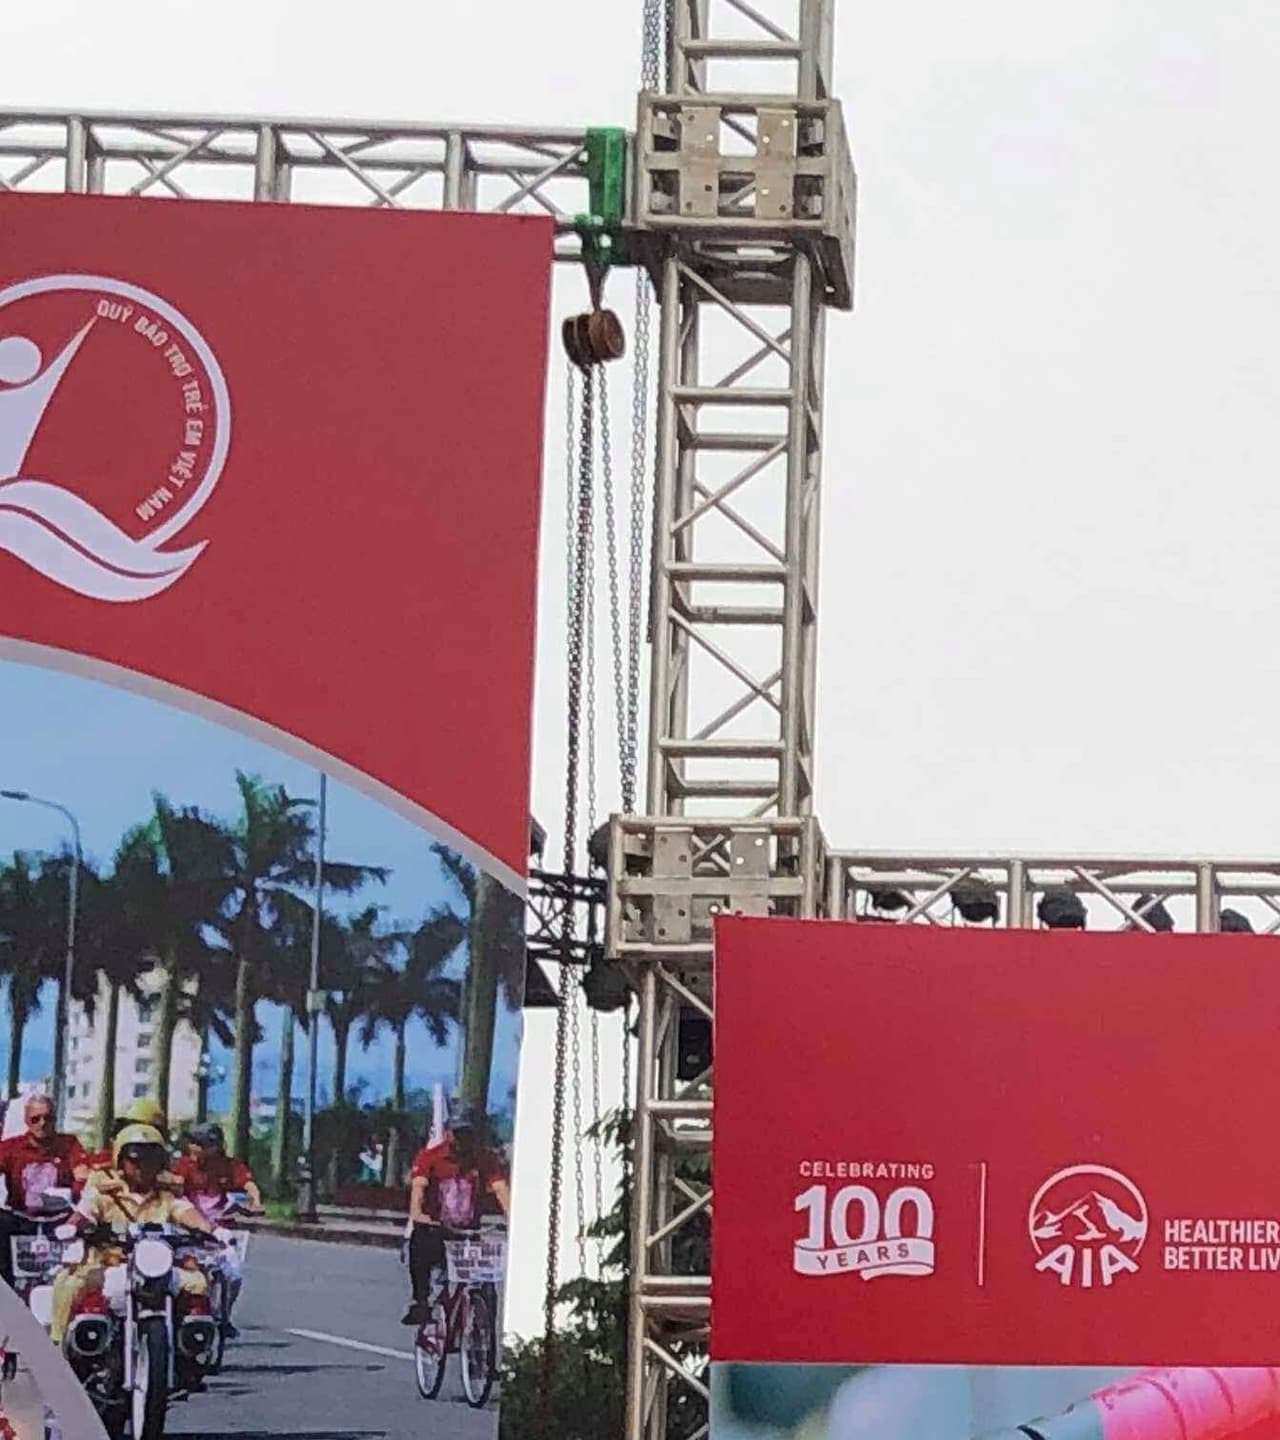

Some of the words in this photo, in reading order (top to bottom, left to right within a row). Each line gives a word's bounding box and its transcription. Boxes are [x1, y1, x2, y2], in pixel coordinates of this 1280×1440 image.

[184, 420, 203, 446] EM
[135, 487, 174, 522] NAM
[800, 1160, 935, 1180] CELEBRATING
[794, 1184, 934, 1250] 100
[816, 1243, 910, 1271] YEARS
[1034, 1244, 1141, 1288] AIA
[1164, 1247, 1244, 1271] BETTER
